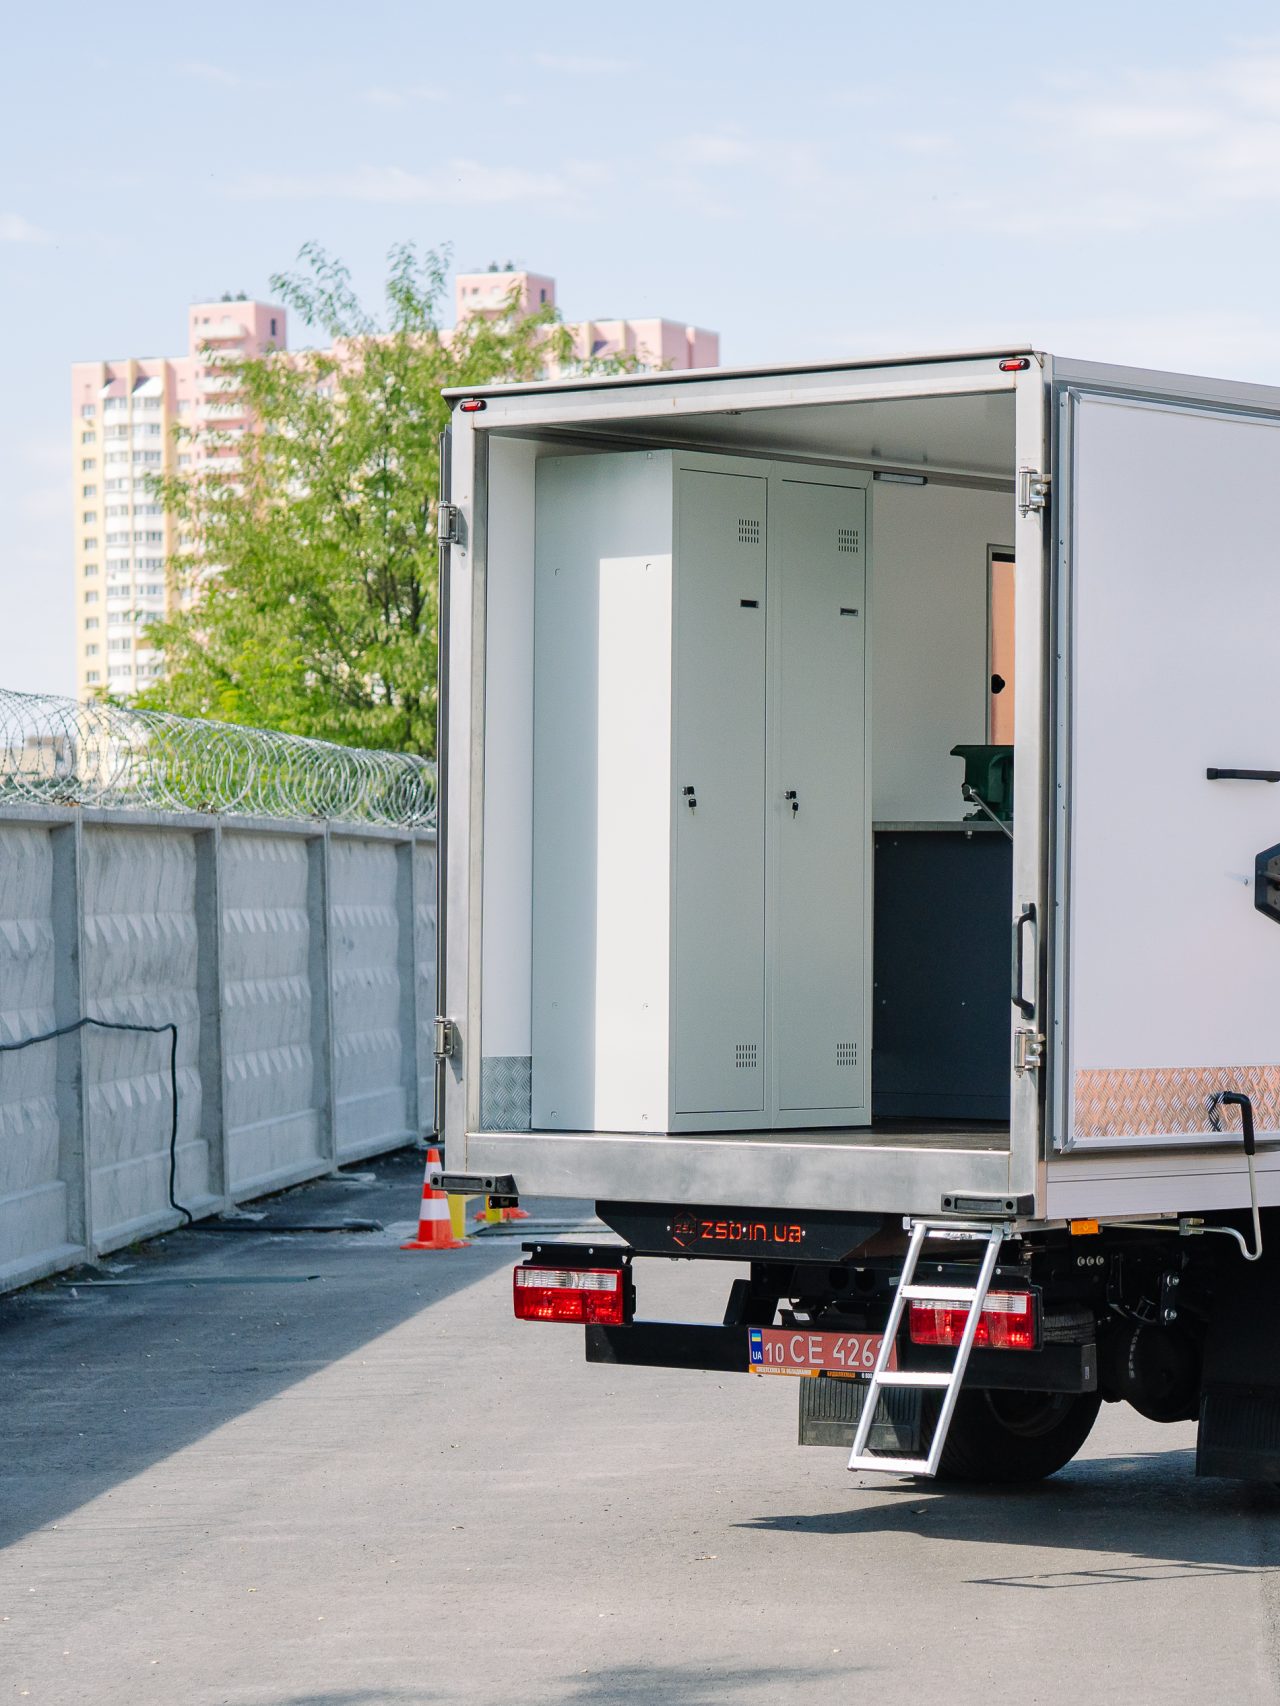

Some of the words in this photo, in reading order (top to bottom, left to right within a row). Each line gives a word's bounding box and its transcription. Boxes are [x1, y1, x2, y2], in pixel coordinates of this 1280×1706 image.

[752, 1350, 763, 1361] UA
[765, 1342, 785, 1363] 10
[789, 1335, 824, 1364] CE
